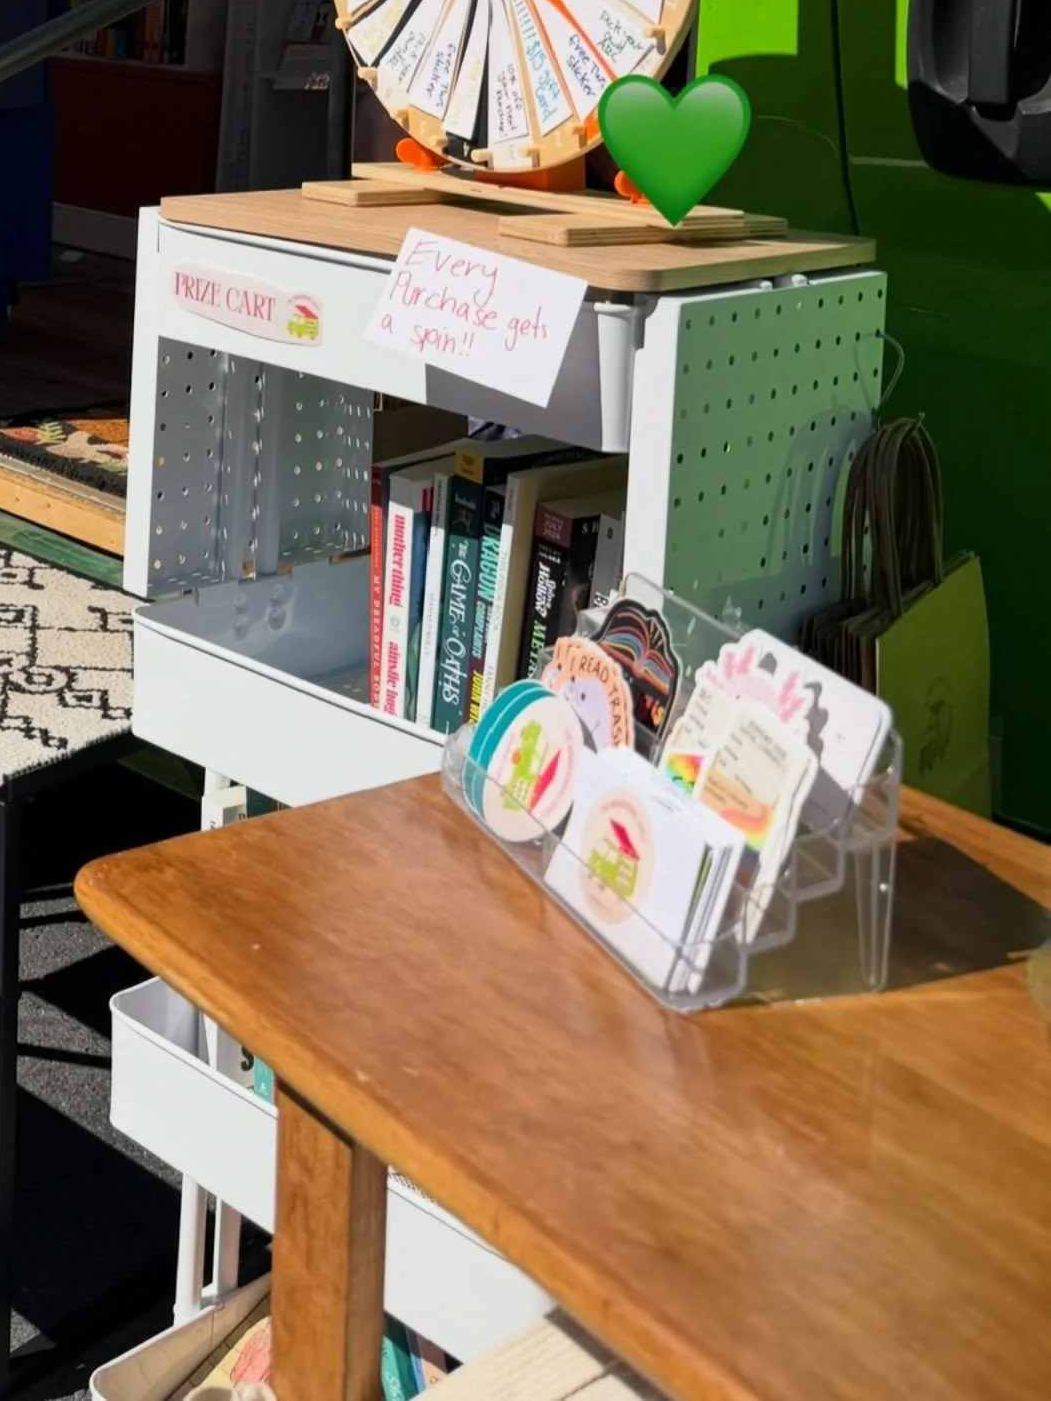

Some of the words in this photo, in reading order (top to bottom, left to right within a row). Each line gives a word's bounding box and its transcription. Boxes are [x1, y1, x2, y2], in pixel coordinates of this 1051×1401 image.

[175, 271, 221, 308] PRIZE
[225, 287, 276, 322] CART
[404, 238, 500, 308] Every
[380, 312, 394, 335] a
[409, 321, 475, 359] spin!!
[507, 305, 549, 352] gets
[457, 539, 468, 559] THE
[477, 522, 501, 603] DRAGON
[373, 573, 381, 595] MY
[449, 559, 472, 624] GAME
[372, 598, 381, 659] DREADFUL
[472, 601, 486, 660] COMPLAINTS
[441, 636, 469, 706] OATHS
[471, 669, 484, 699] JOHN
[578, 654, 609, 684] READ
